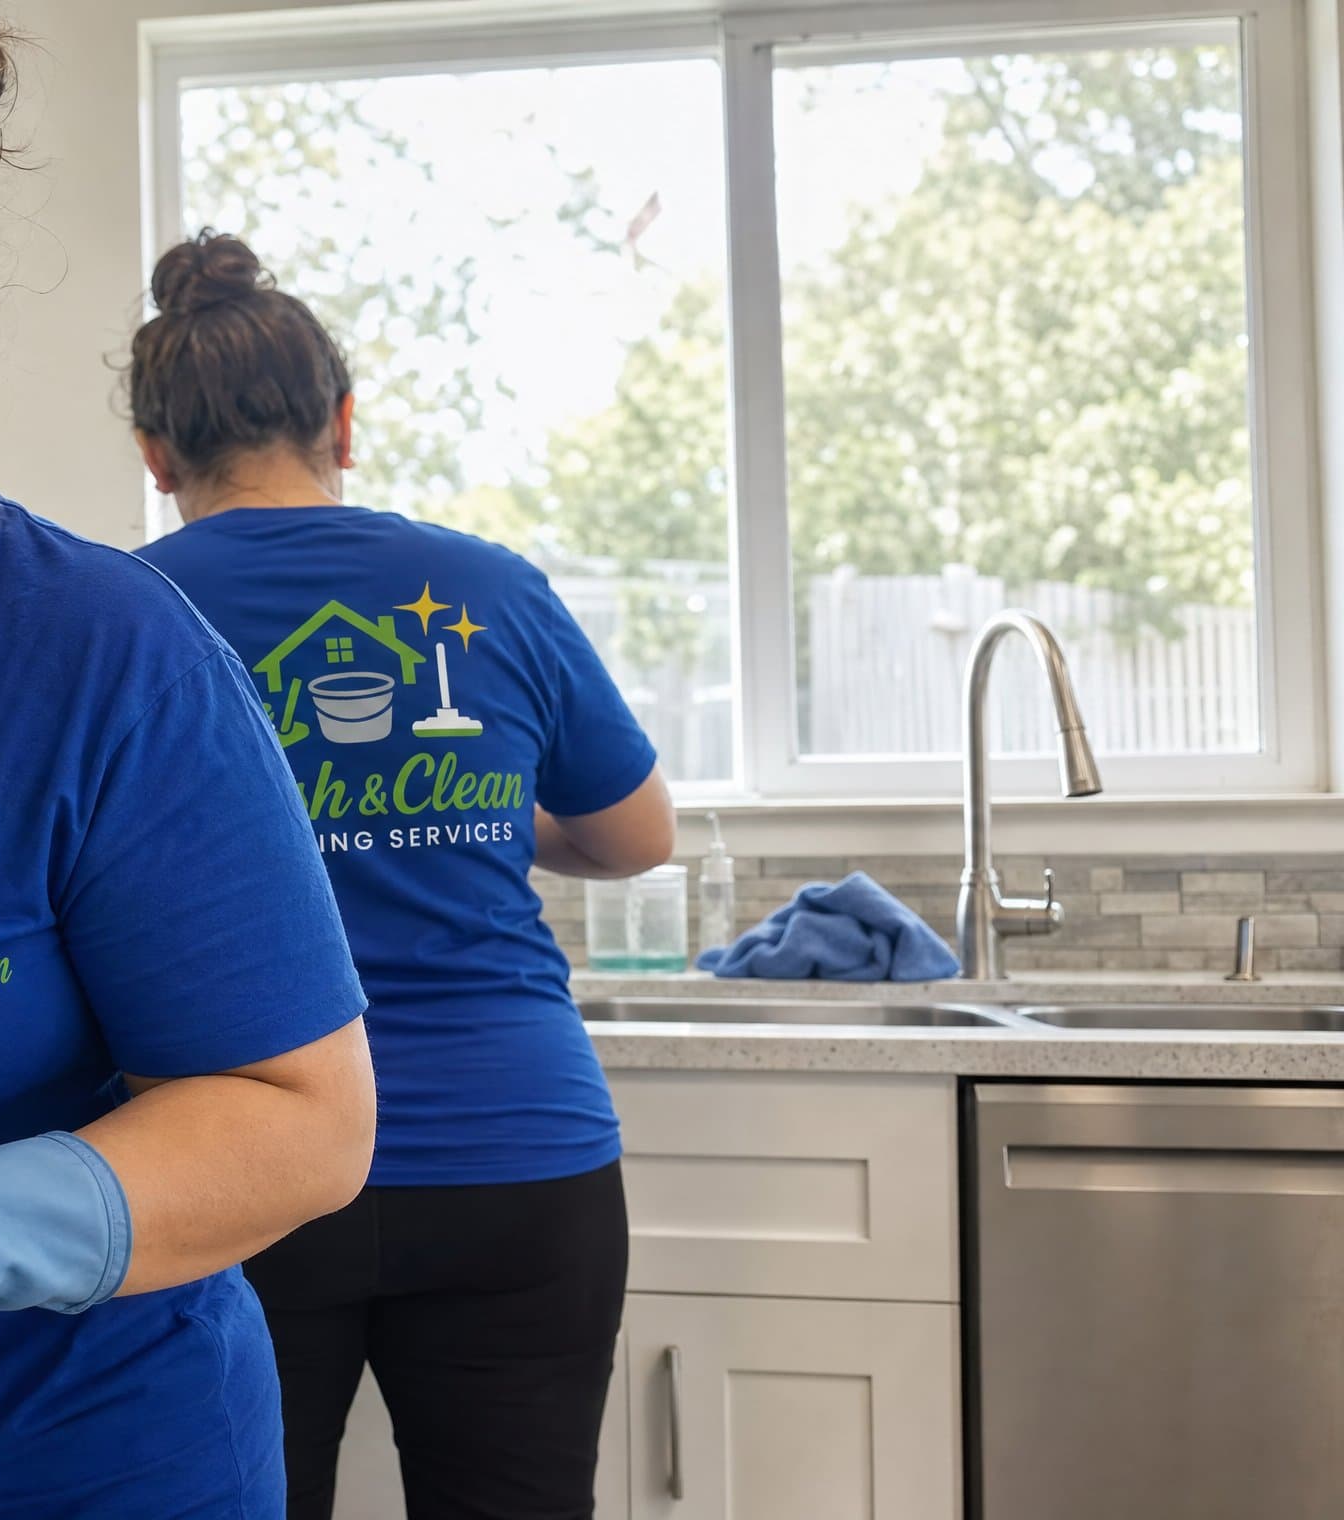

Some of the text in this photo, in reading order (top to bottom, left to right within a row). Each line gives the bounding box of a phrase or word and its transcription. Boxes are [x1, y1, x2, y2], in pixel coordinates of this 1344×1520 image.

[358, 773, 389, 816] &
[392, 751, 525, 815] Clean
[389, 821, 513, 849] SERVICES
